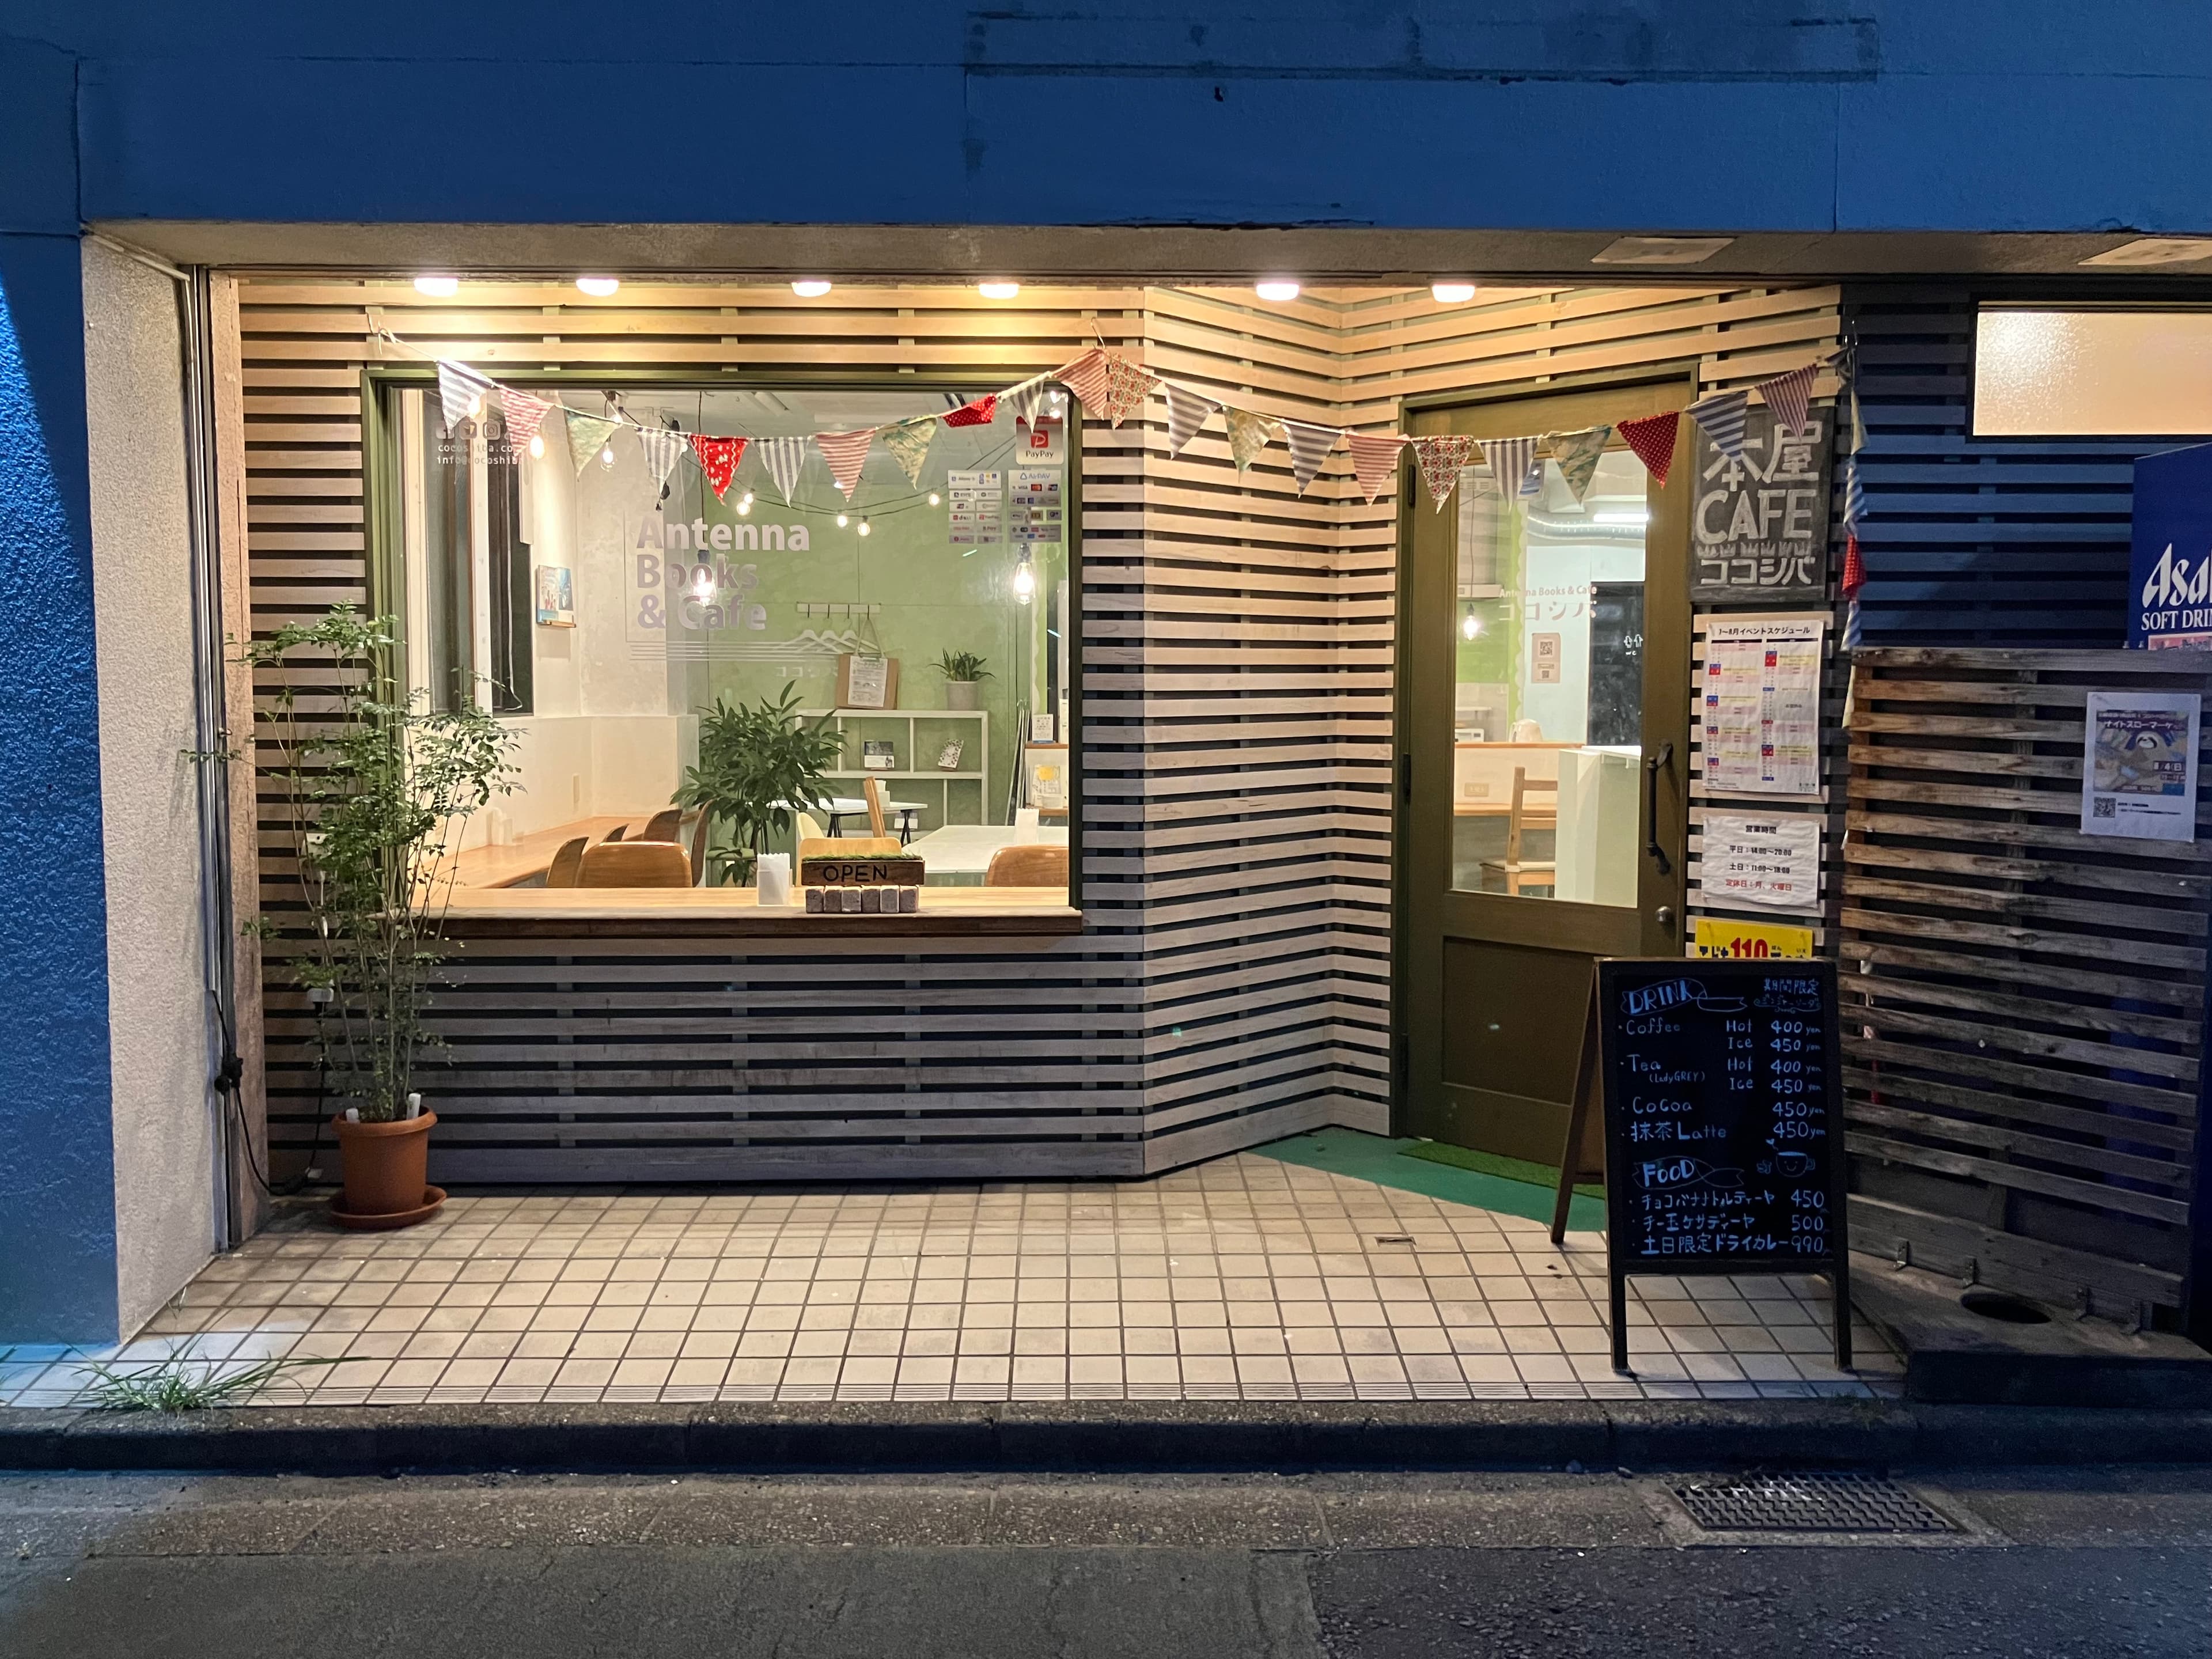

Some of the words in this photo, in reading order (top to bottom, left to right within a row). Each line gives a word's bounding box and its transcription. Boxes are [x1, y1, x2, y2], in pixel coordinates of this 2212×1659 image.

[1025, 450, 1054, 459] PayPay
[1695, 489, 1816, 544] CAFE
[637, 517, 810, 551] Antenna
[637, 553, 757, 589] Books
[1700, 556, 1816, 585] ココシバ
[2142, 543, 2212, 608] Asa
[1539, 586, 1565, 596] Books
[1567, 585, 1574, 595] &
[1577, 584, 1597, 594] Cafe
[637, 594, 666, 629] &
[677, 594, 767, 630] Cafe
[2141, 611, 2179, 630] SOFT
[2181, 609, 2212, 628] DRI
[1745, 825, 1777, 834] 営業時間
[823, 865, 888, 882] OPEN
[1764, 978, 1819, 995] 期間限定
[1628, 980, 1692, 1014] DRINK
[1626, 1017, 1680, 1035] Coffee
[1726, 1018, 1752, 1033] Hot
[1771, 1020, 1802, 1034] 400
[1728, 1037, 1753, 1049] Ice
[1770, 1038, 1801, 1052] 450
[1627, 1054, 1661, 1072] Tea
[1728, 1055, 1753, 1073] Hot
[1770, 1059, 1801, 1075] 400
[1730, 1077, 1753, 1090] Ice
[1771, 1079, 1802, 1093] 450
[1772, 1101, 1806, 1117] 450
[1773, 1121, 1809, 1138] 450
[1790, 1188, 1824, 1208] 450
[1791, 1214, 1823, 1231] 500
[1641, 1232, 1789, 1255] 土日限定ドライカレー
[1791, 1235, 1823, 1253] 990
